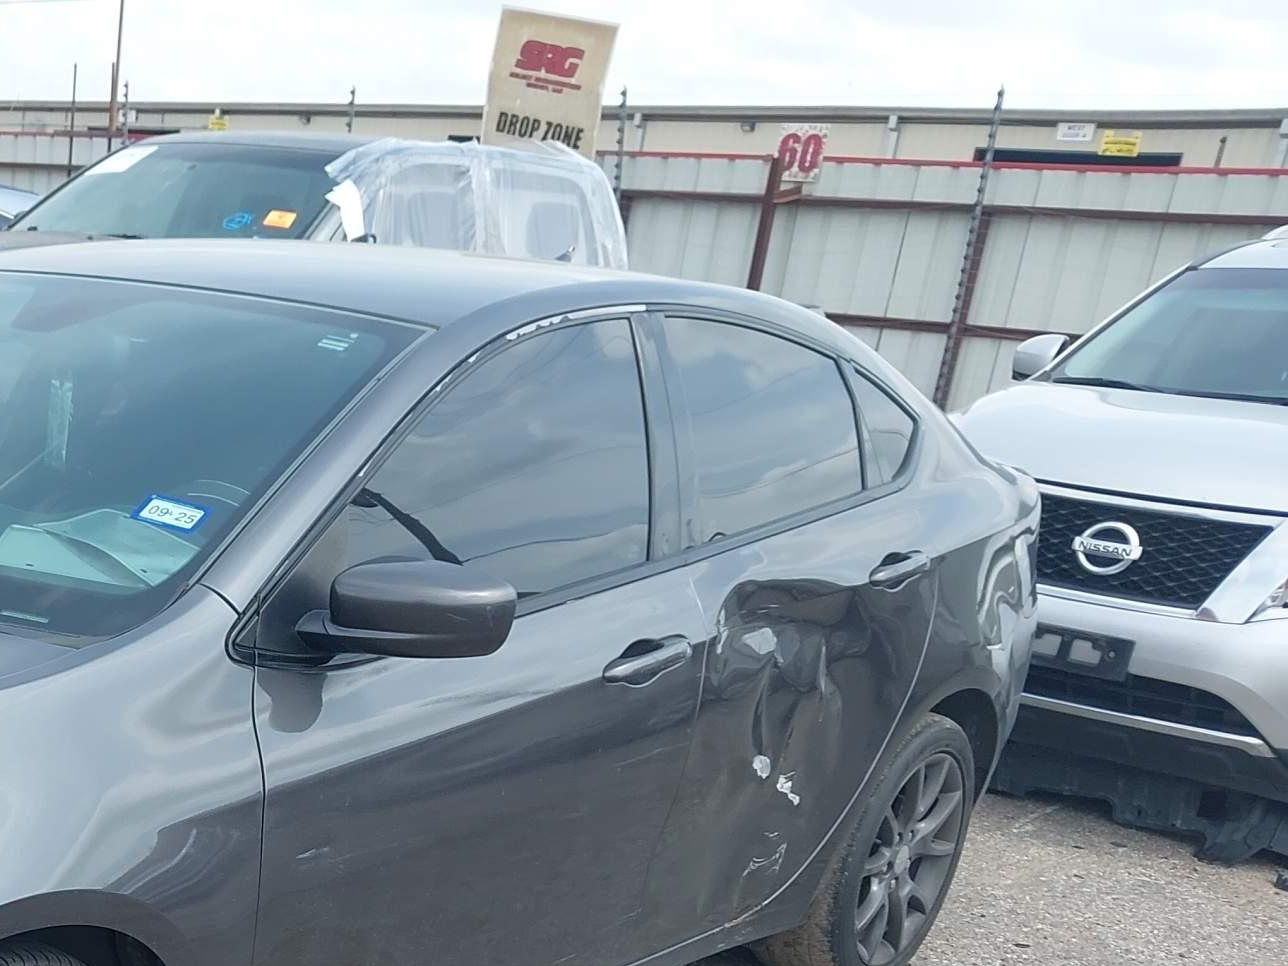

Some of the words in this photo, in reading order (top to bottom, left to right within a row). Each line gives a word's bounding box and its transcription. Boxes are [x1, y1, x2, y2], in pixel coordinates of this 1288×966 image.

[515, 40, 585, 78] SRG
[495, 111, 541, 139] DROP
[541, 121, 585, 150] ZONE
[778, 133, 822, 173] 60
[148, 505, 169, 517] 09
[175, 512, 197, 524] 25
[1078, 541, 1132, 556] NISSAN
